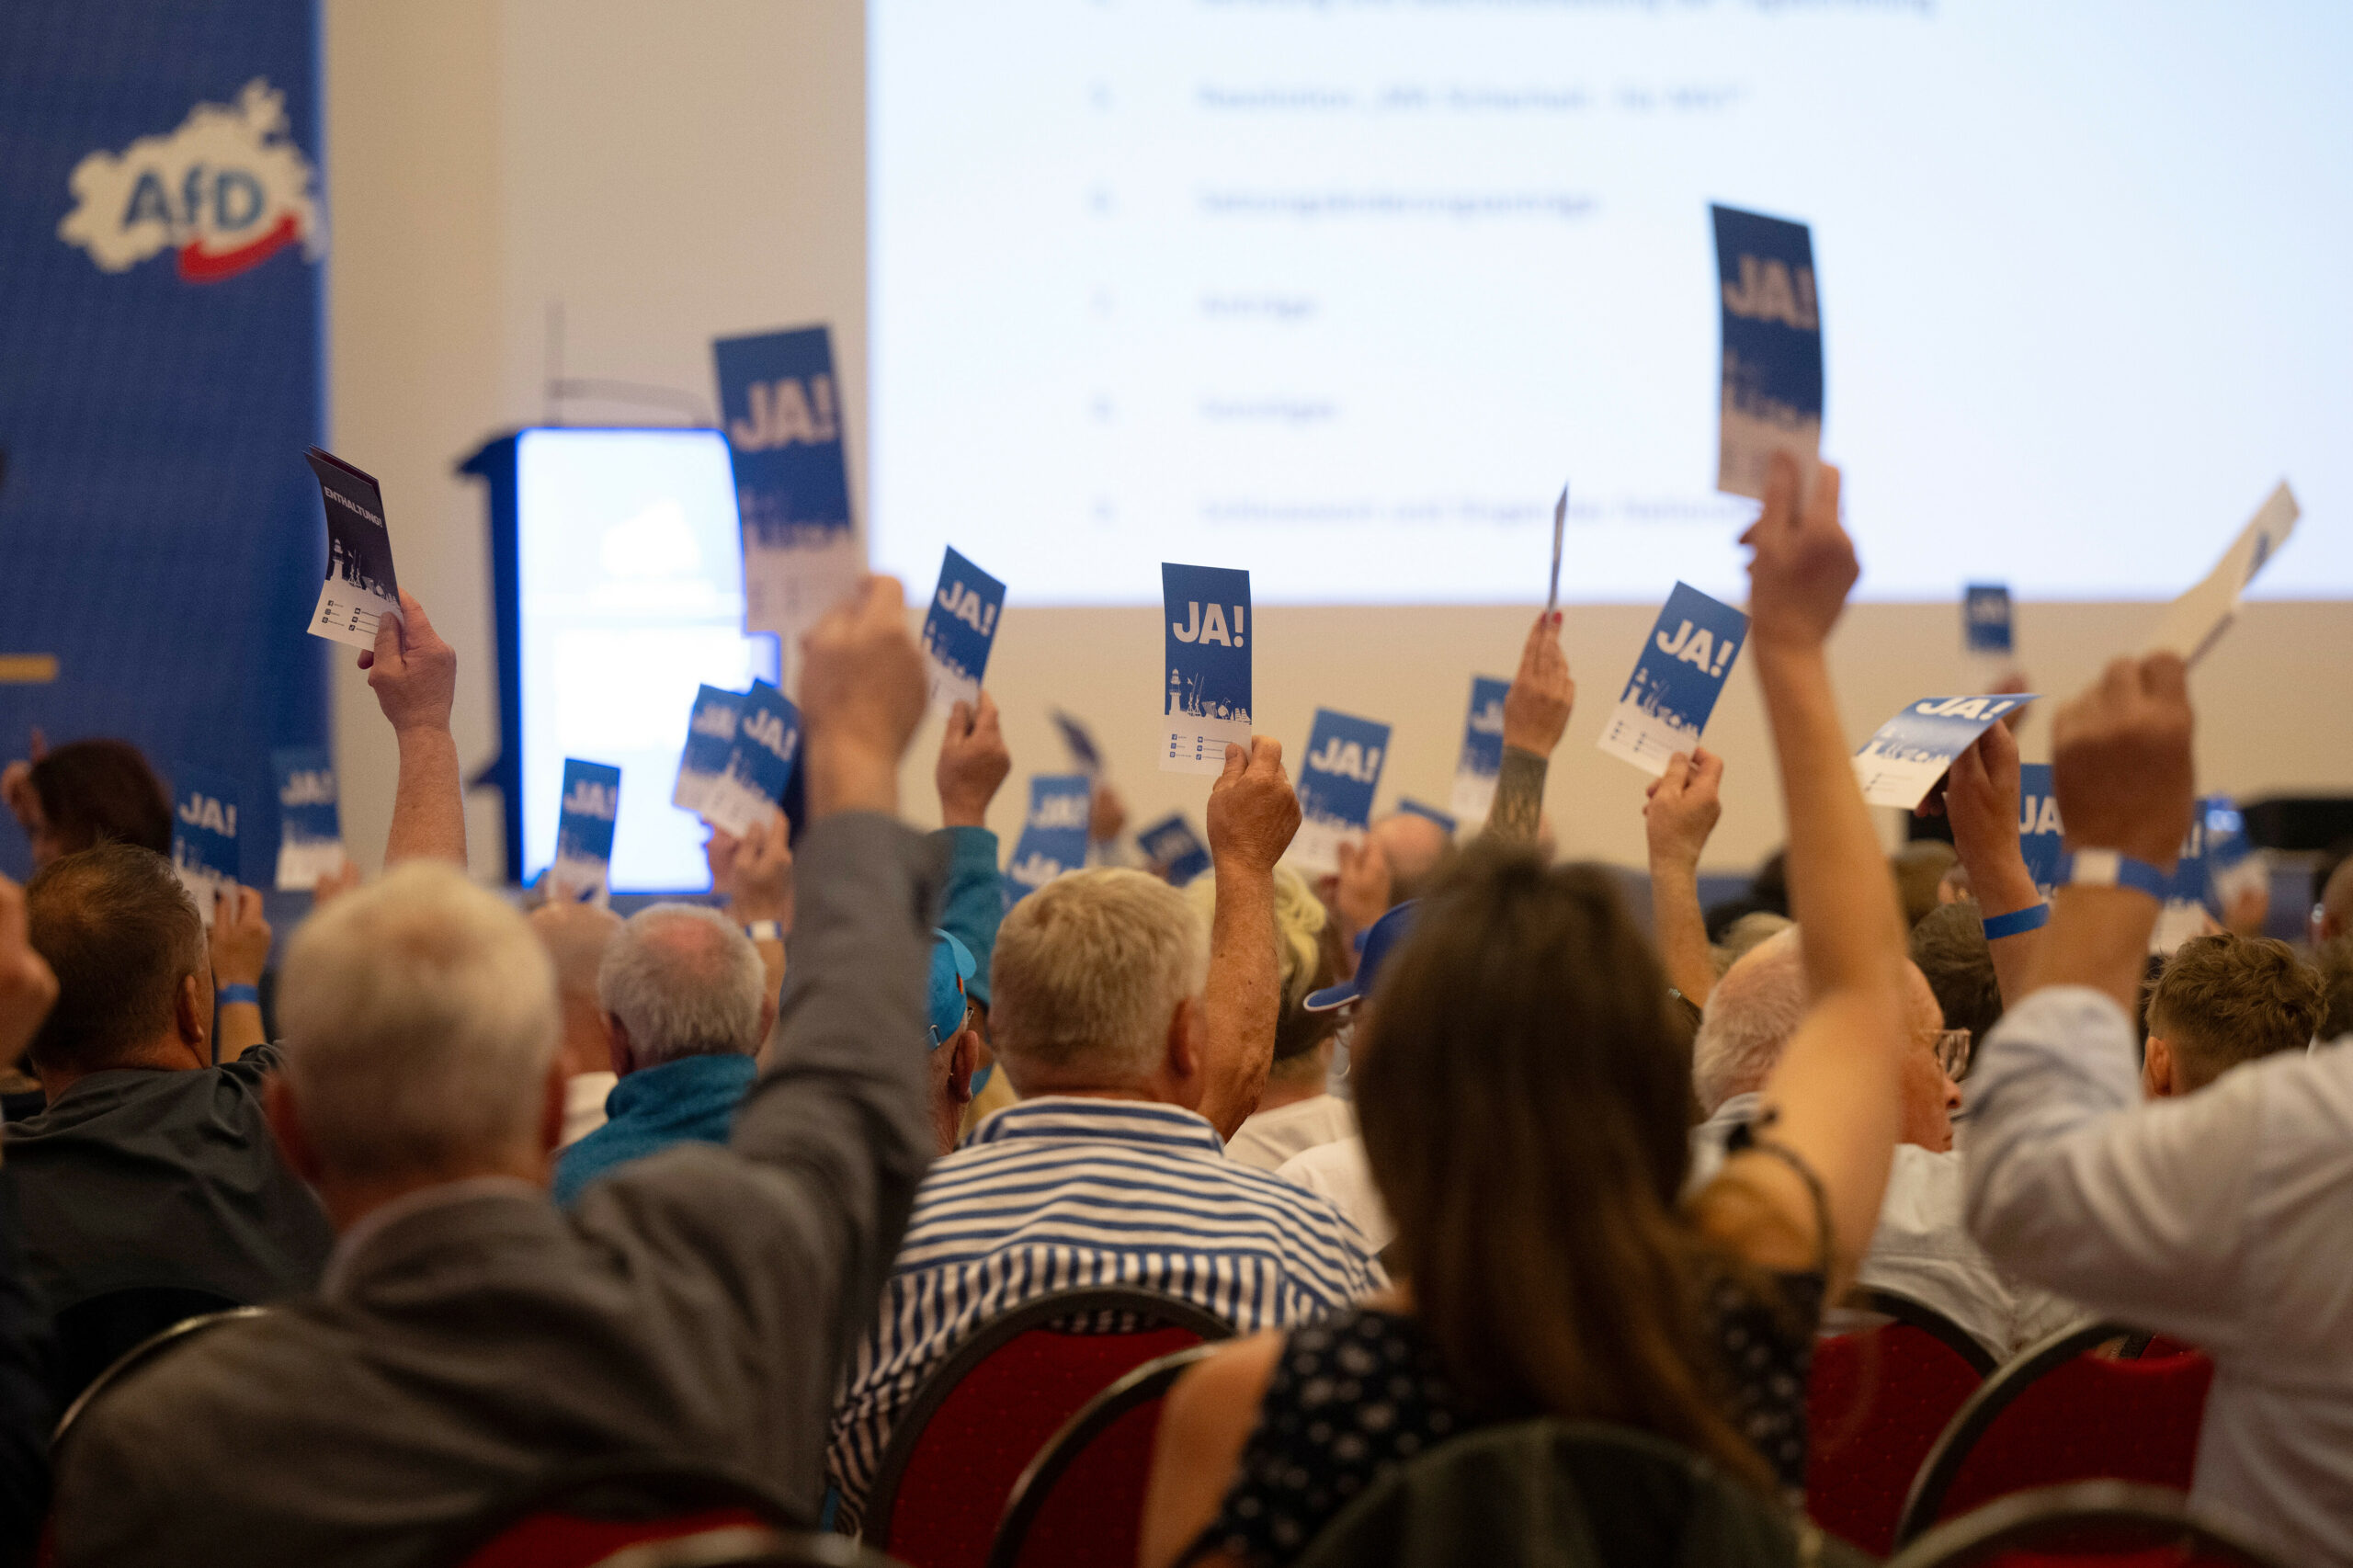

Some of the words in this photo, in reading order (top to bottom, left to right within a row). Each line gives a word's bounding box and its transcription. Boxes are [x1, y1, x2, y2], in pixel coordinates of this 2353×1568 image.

[125, 162, 265, 232] AfD
[1722, 254, 1819, 329] JA!
[733, 373, 835, 452] JA!
[324, 485, 383, 528] ENTHALTUNG!
[938, 580, 996, 637] JA!
[1173, 600, 1245, 648] JA!
[1656, 619, 1734, 678] JA!
[1915, 697, 2016, 721] JA!
[743, 708, 797, 761] JA!
[1309, 737, 1381, 783] JA!
[178, 791, 237, 838] JA!
[563, 779, 617, 821] JA!
[2018, 795, 2066, 836] JA
